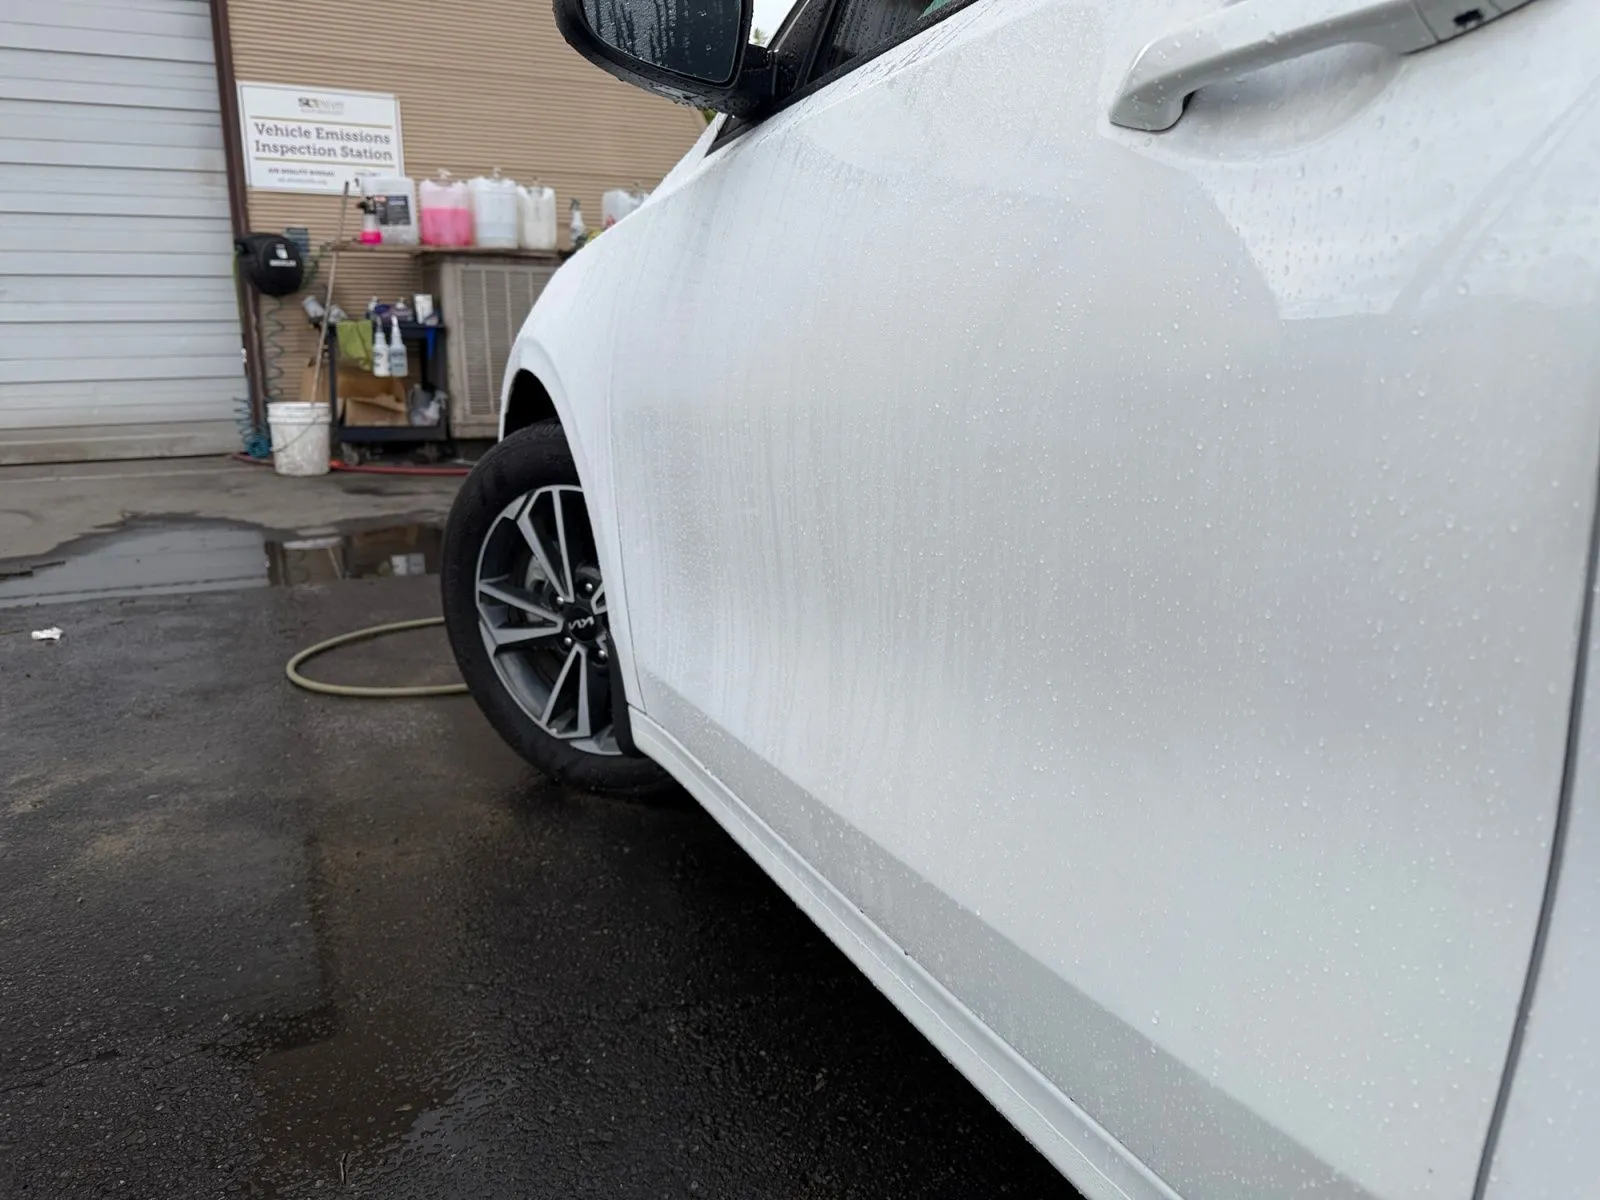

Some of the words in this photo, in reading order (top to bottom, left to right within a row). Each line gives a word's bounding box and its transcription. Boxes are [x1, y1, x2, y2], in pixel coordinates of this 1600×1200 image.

[254, 122, 312, 139] Vehicle
[315, 127, 391, 145] Emissions
[255, 140, 337, 158] Inspection
[340, 145, 393, 161] Station
